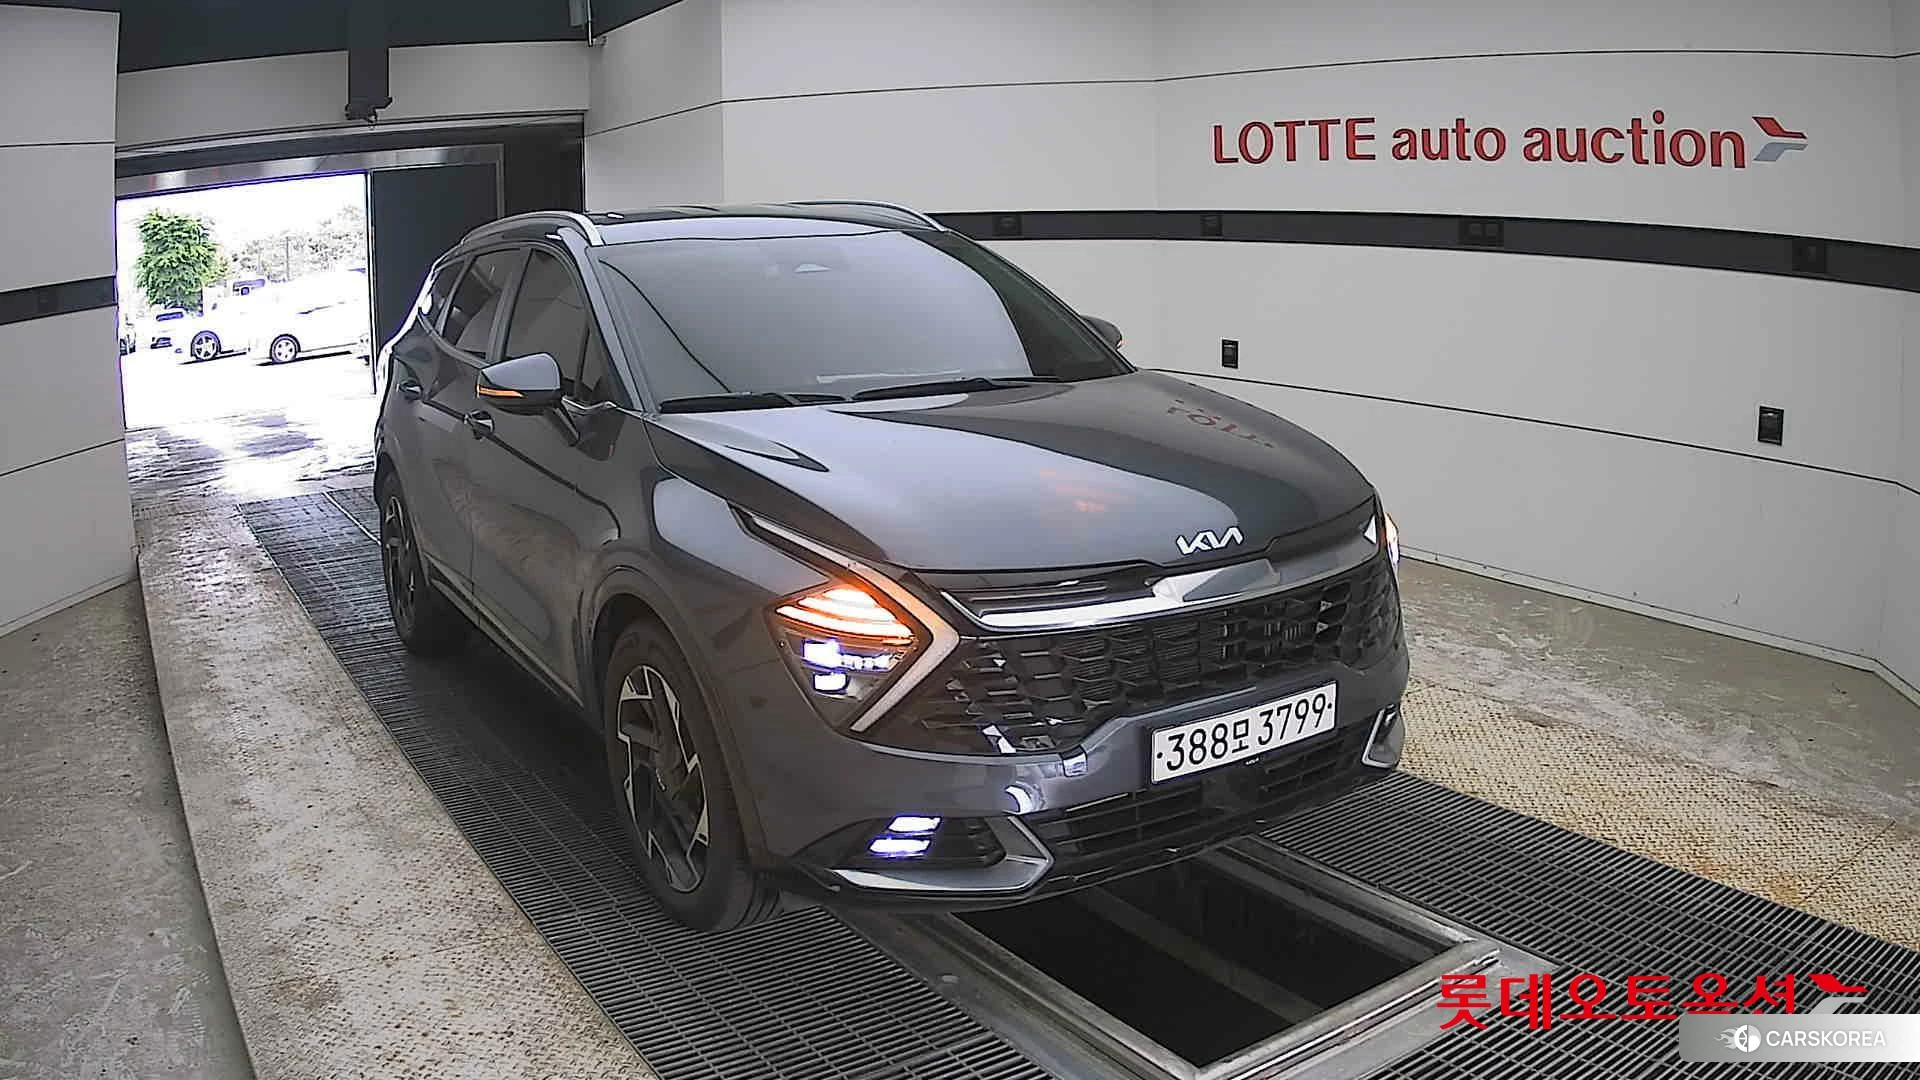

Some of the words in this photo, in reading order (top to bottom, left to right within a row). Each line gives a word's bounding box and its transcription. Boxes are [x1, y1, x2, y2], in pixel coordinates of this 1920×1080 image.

[1212, 117, 1377, 165] LOTTE
[1391, 117, 1507, 163] auto
[1521, 109, 1747, 169] auction
[1175, 526, 1245, 556] KIA
